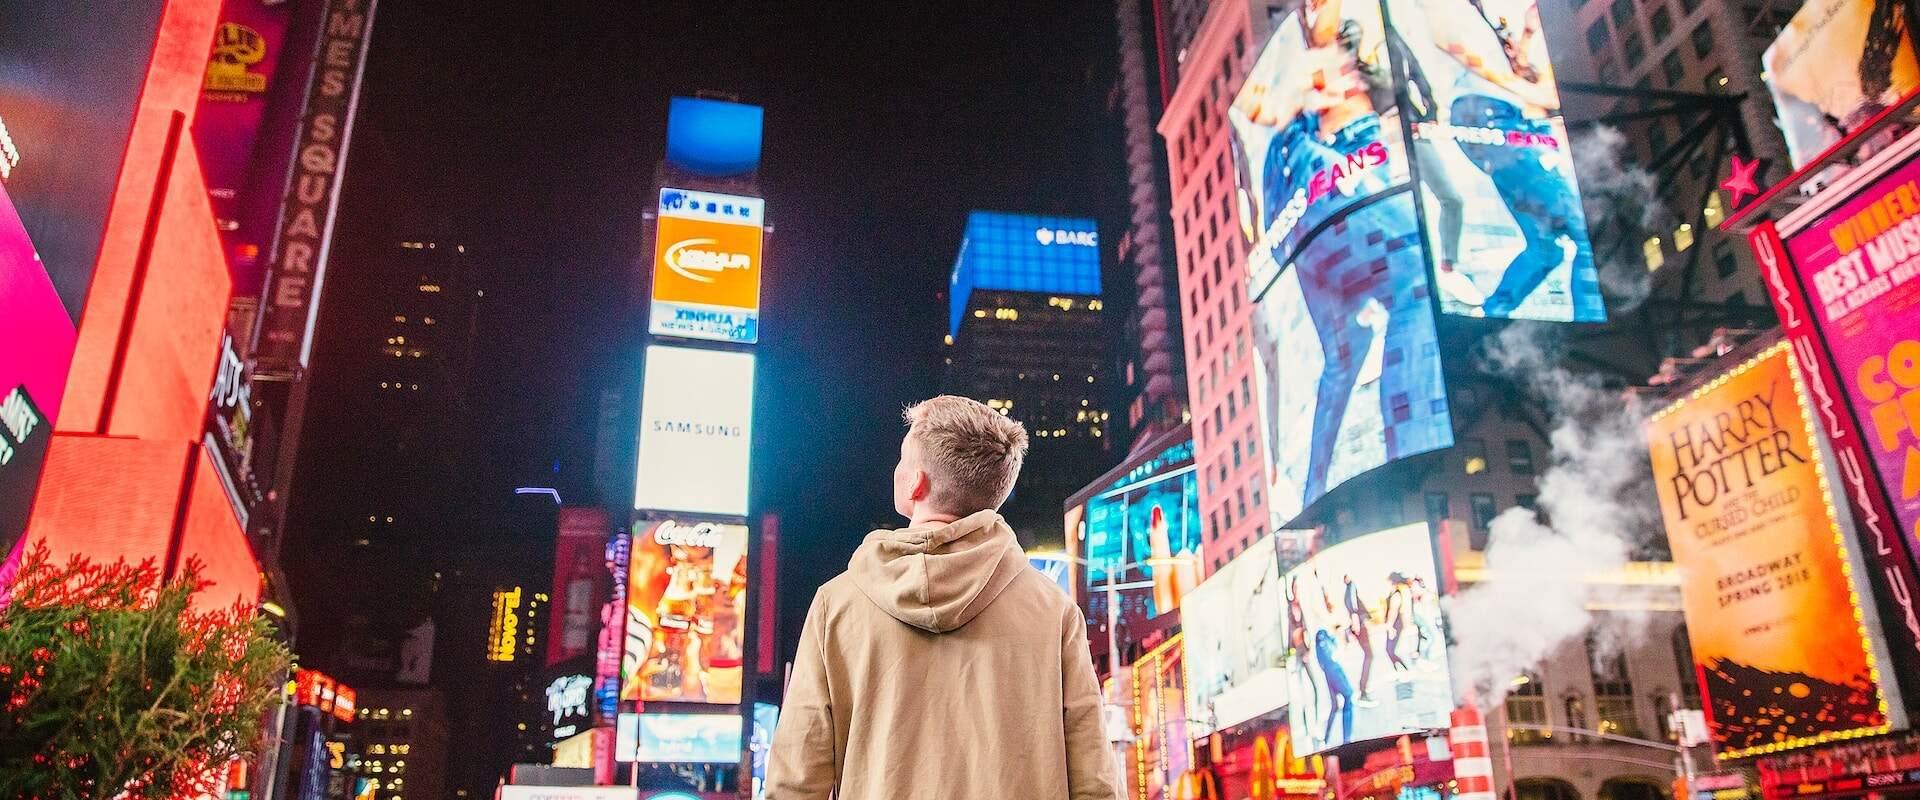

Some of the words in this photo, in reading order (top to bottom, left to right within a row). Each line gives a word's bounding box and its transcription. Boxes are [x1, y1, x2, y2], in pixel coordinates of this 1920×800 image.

[1307, 141, 1388, 205] JEANS
[274, 113, 337, 308] SQUARE
[1813, 248, 1869, 305] BEST
[654, 420, 741, 437] SAMSUNG
[1670, 380, 1778, 475] HARRY
[1672, 430, 1807, 520] POTTER
[1752, 486, 1801, 517] CHILD
[1717, 552, 1801, 591] BROADWAY
[1718, 582, 1772, 608] SPRING
